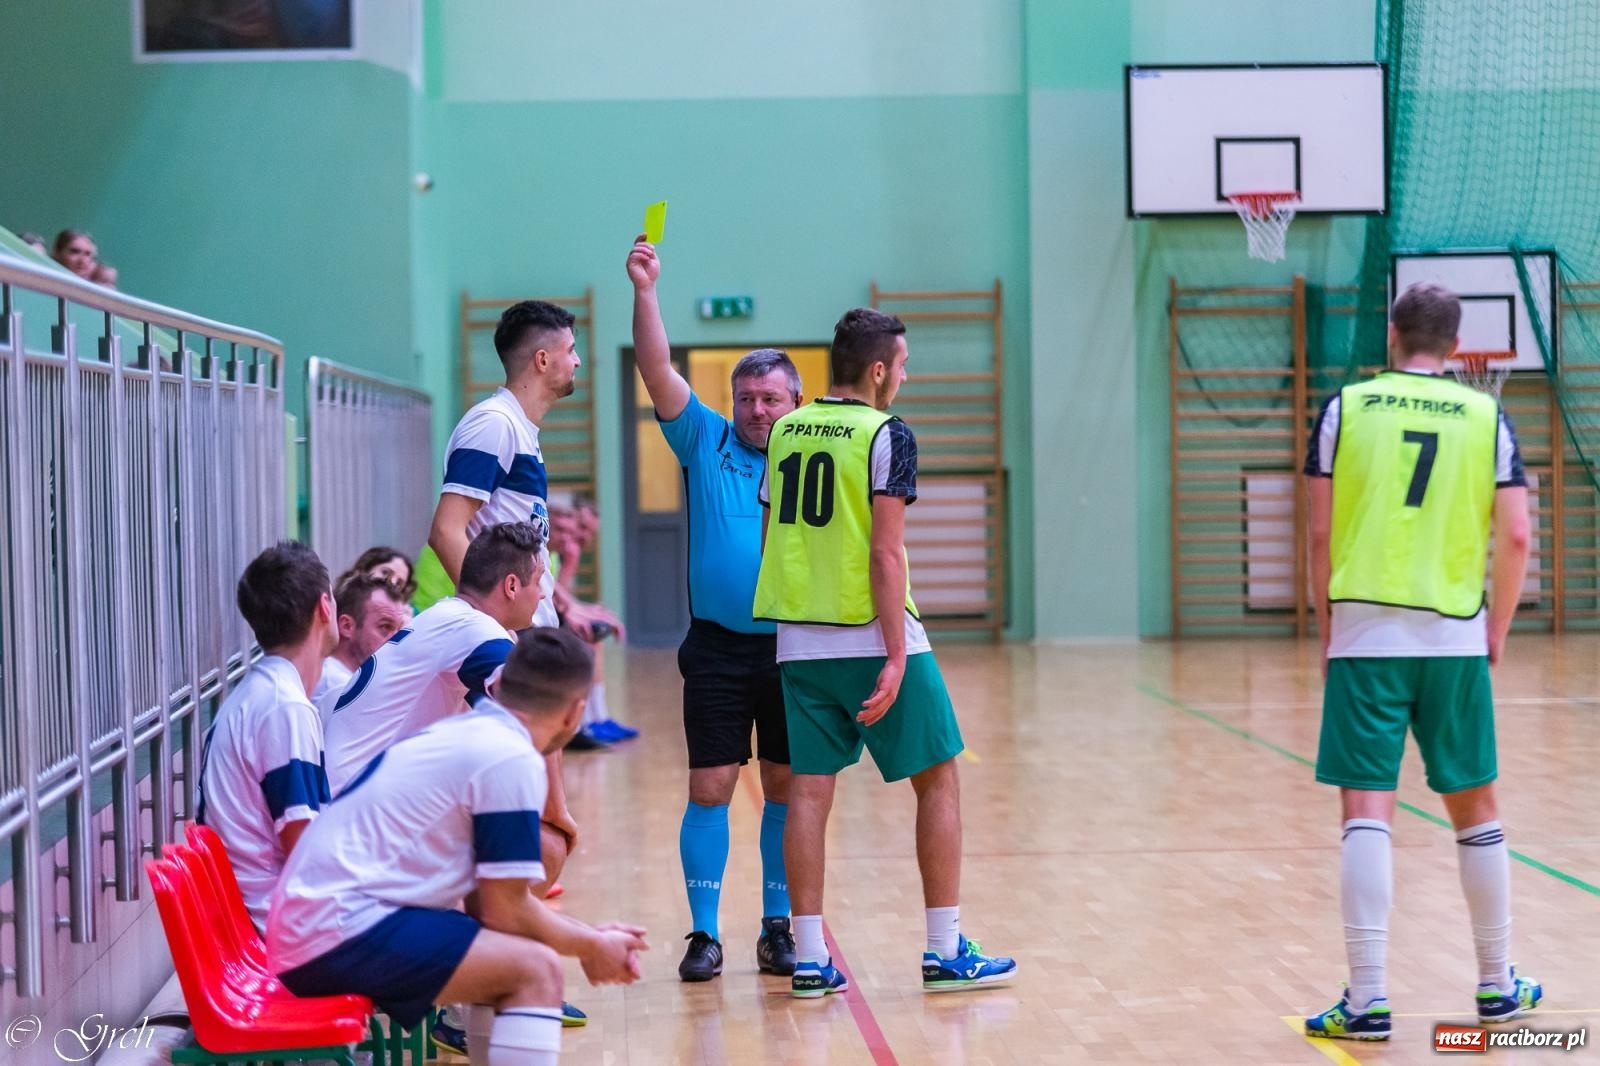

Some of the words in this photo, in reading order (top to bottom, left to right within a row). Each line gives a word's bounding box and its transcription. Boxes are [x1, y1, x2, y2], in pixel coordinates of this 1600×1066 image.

[1386, 395, 1466, 416] PATRICK
[795, 423, 856, 439] PATRICK
[777, 451, 835, 528] 10
[1402, 429, 1439, 508] 7
